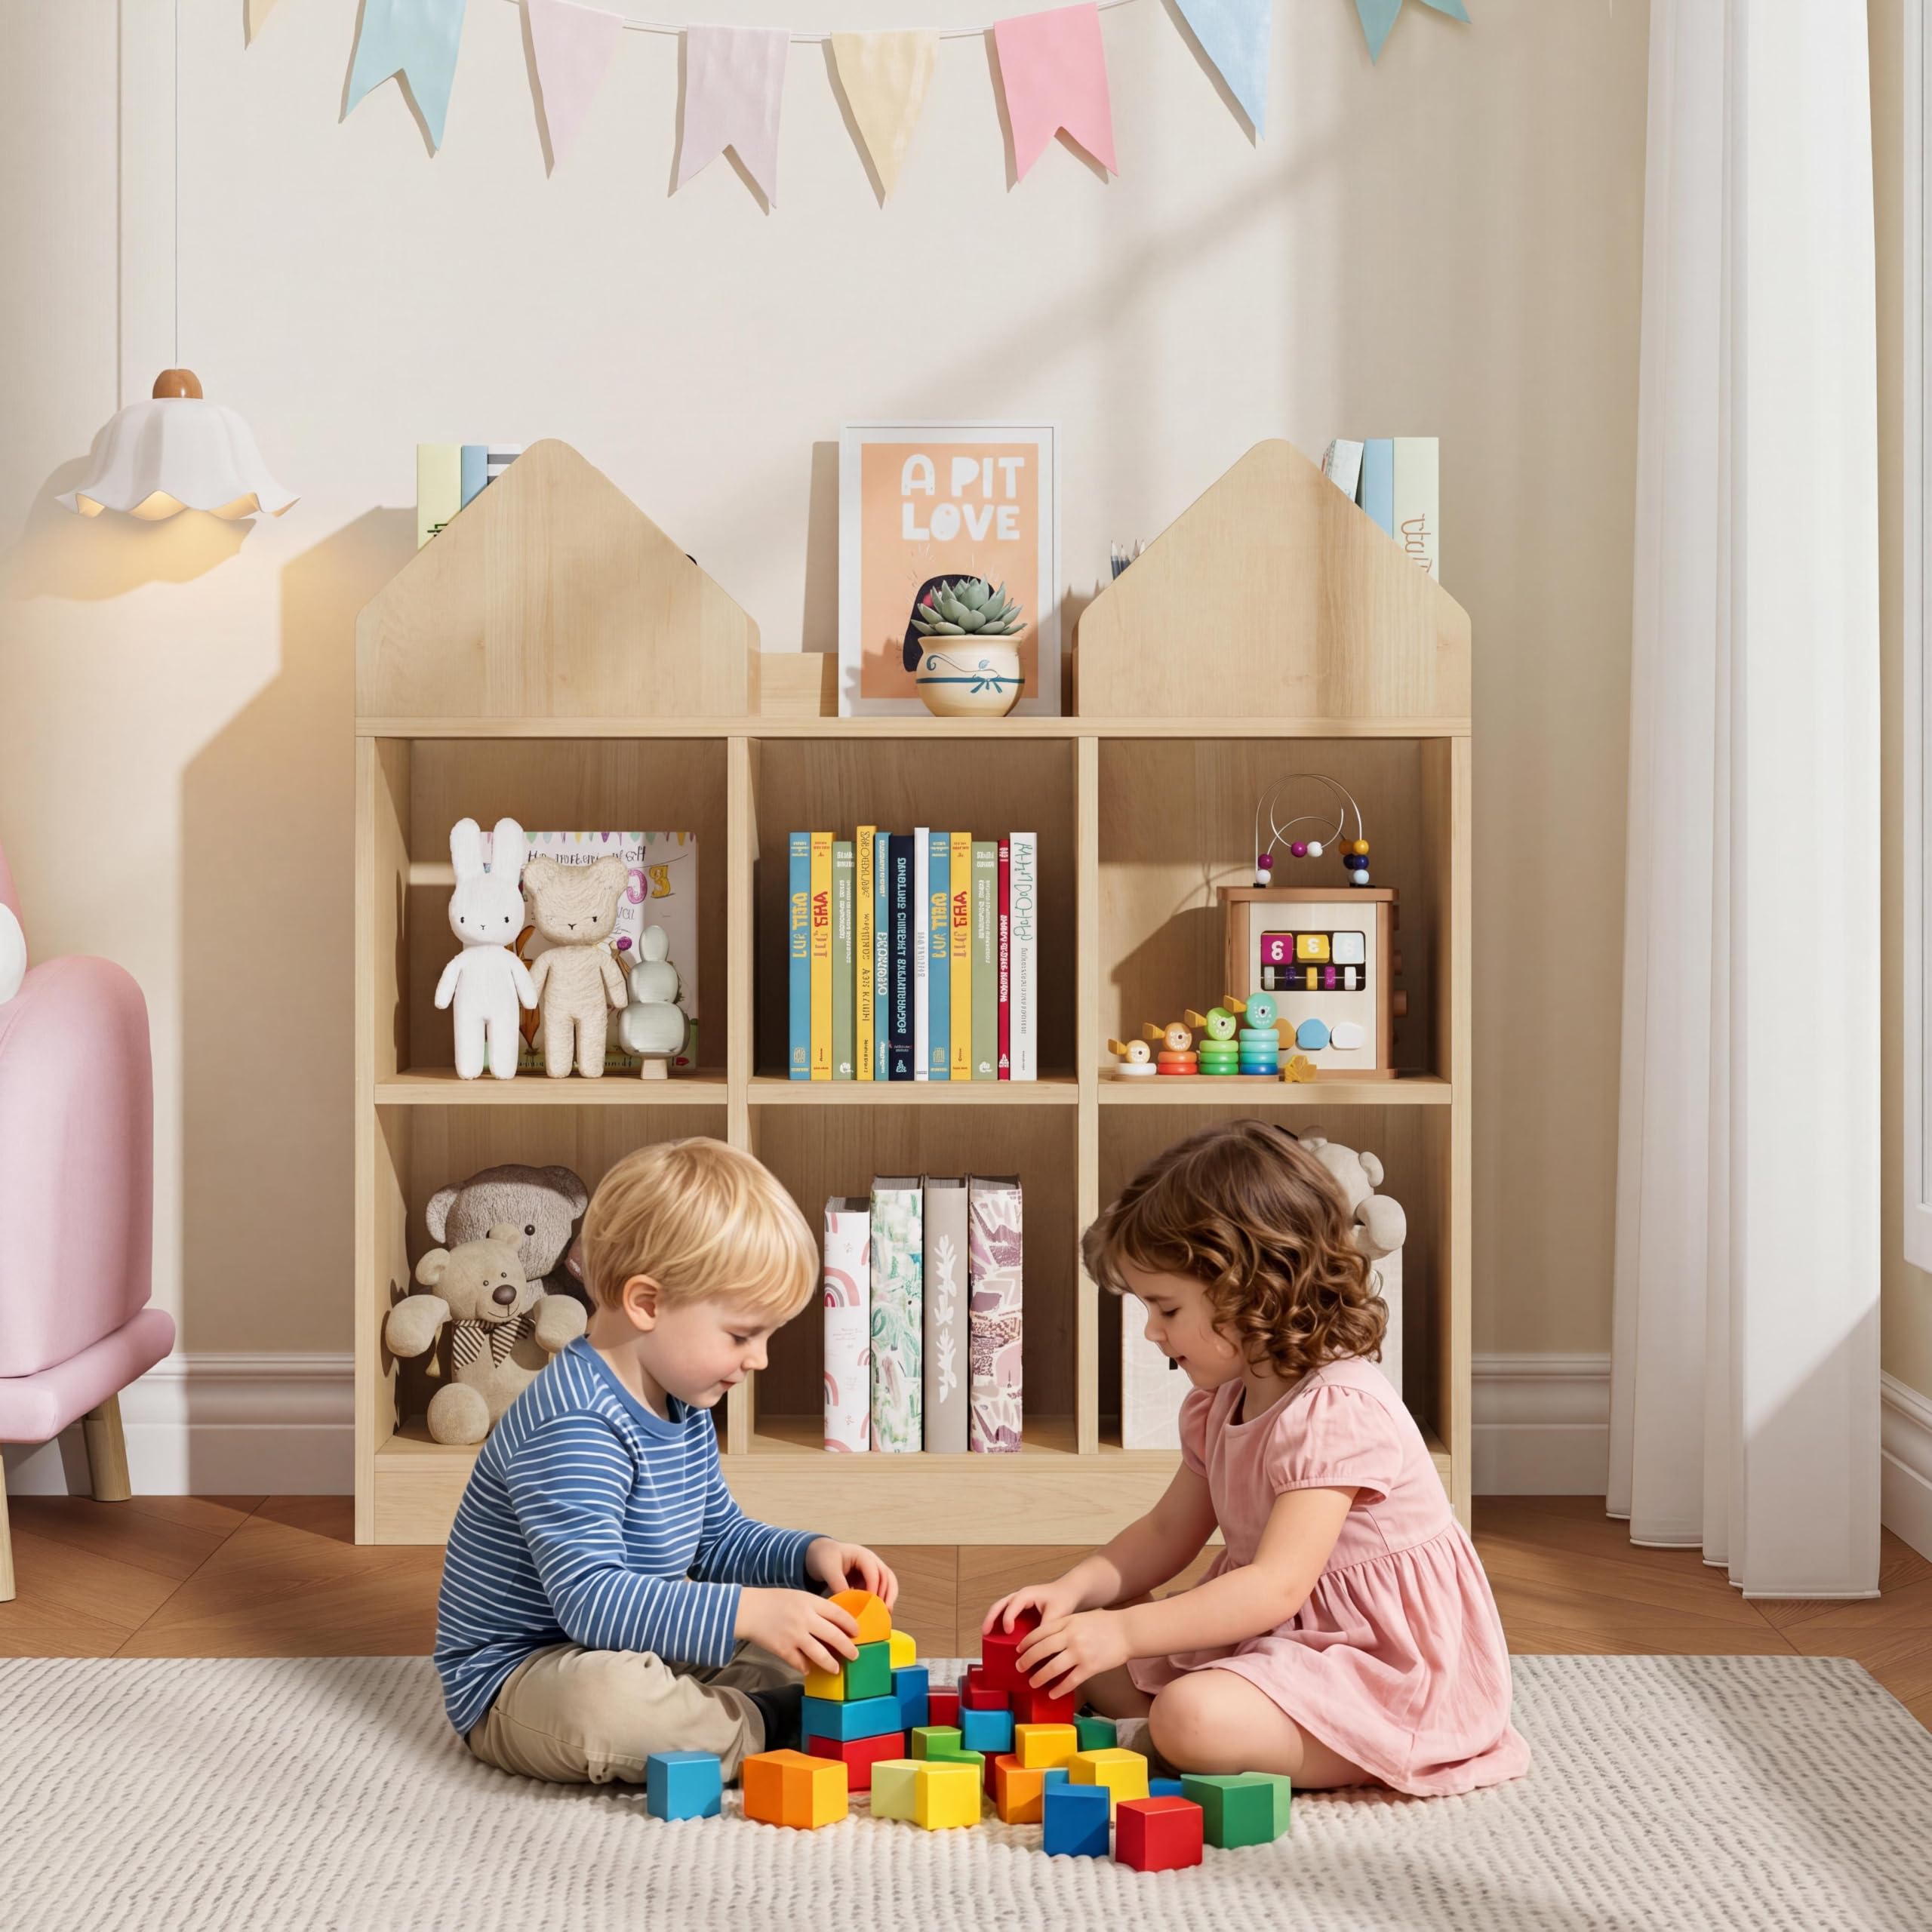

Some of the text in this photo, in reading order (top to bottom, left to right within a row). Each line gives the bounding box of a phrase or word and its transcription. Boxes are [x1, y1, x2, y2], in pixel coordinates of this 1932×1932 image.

[901, 454, 1025, 499] A PIT
[902, 501, 1021, 541] LOVE
